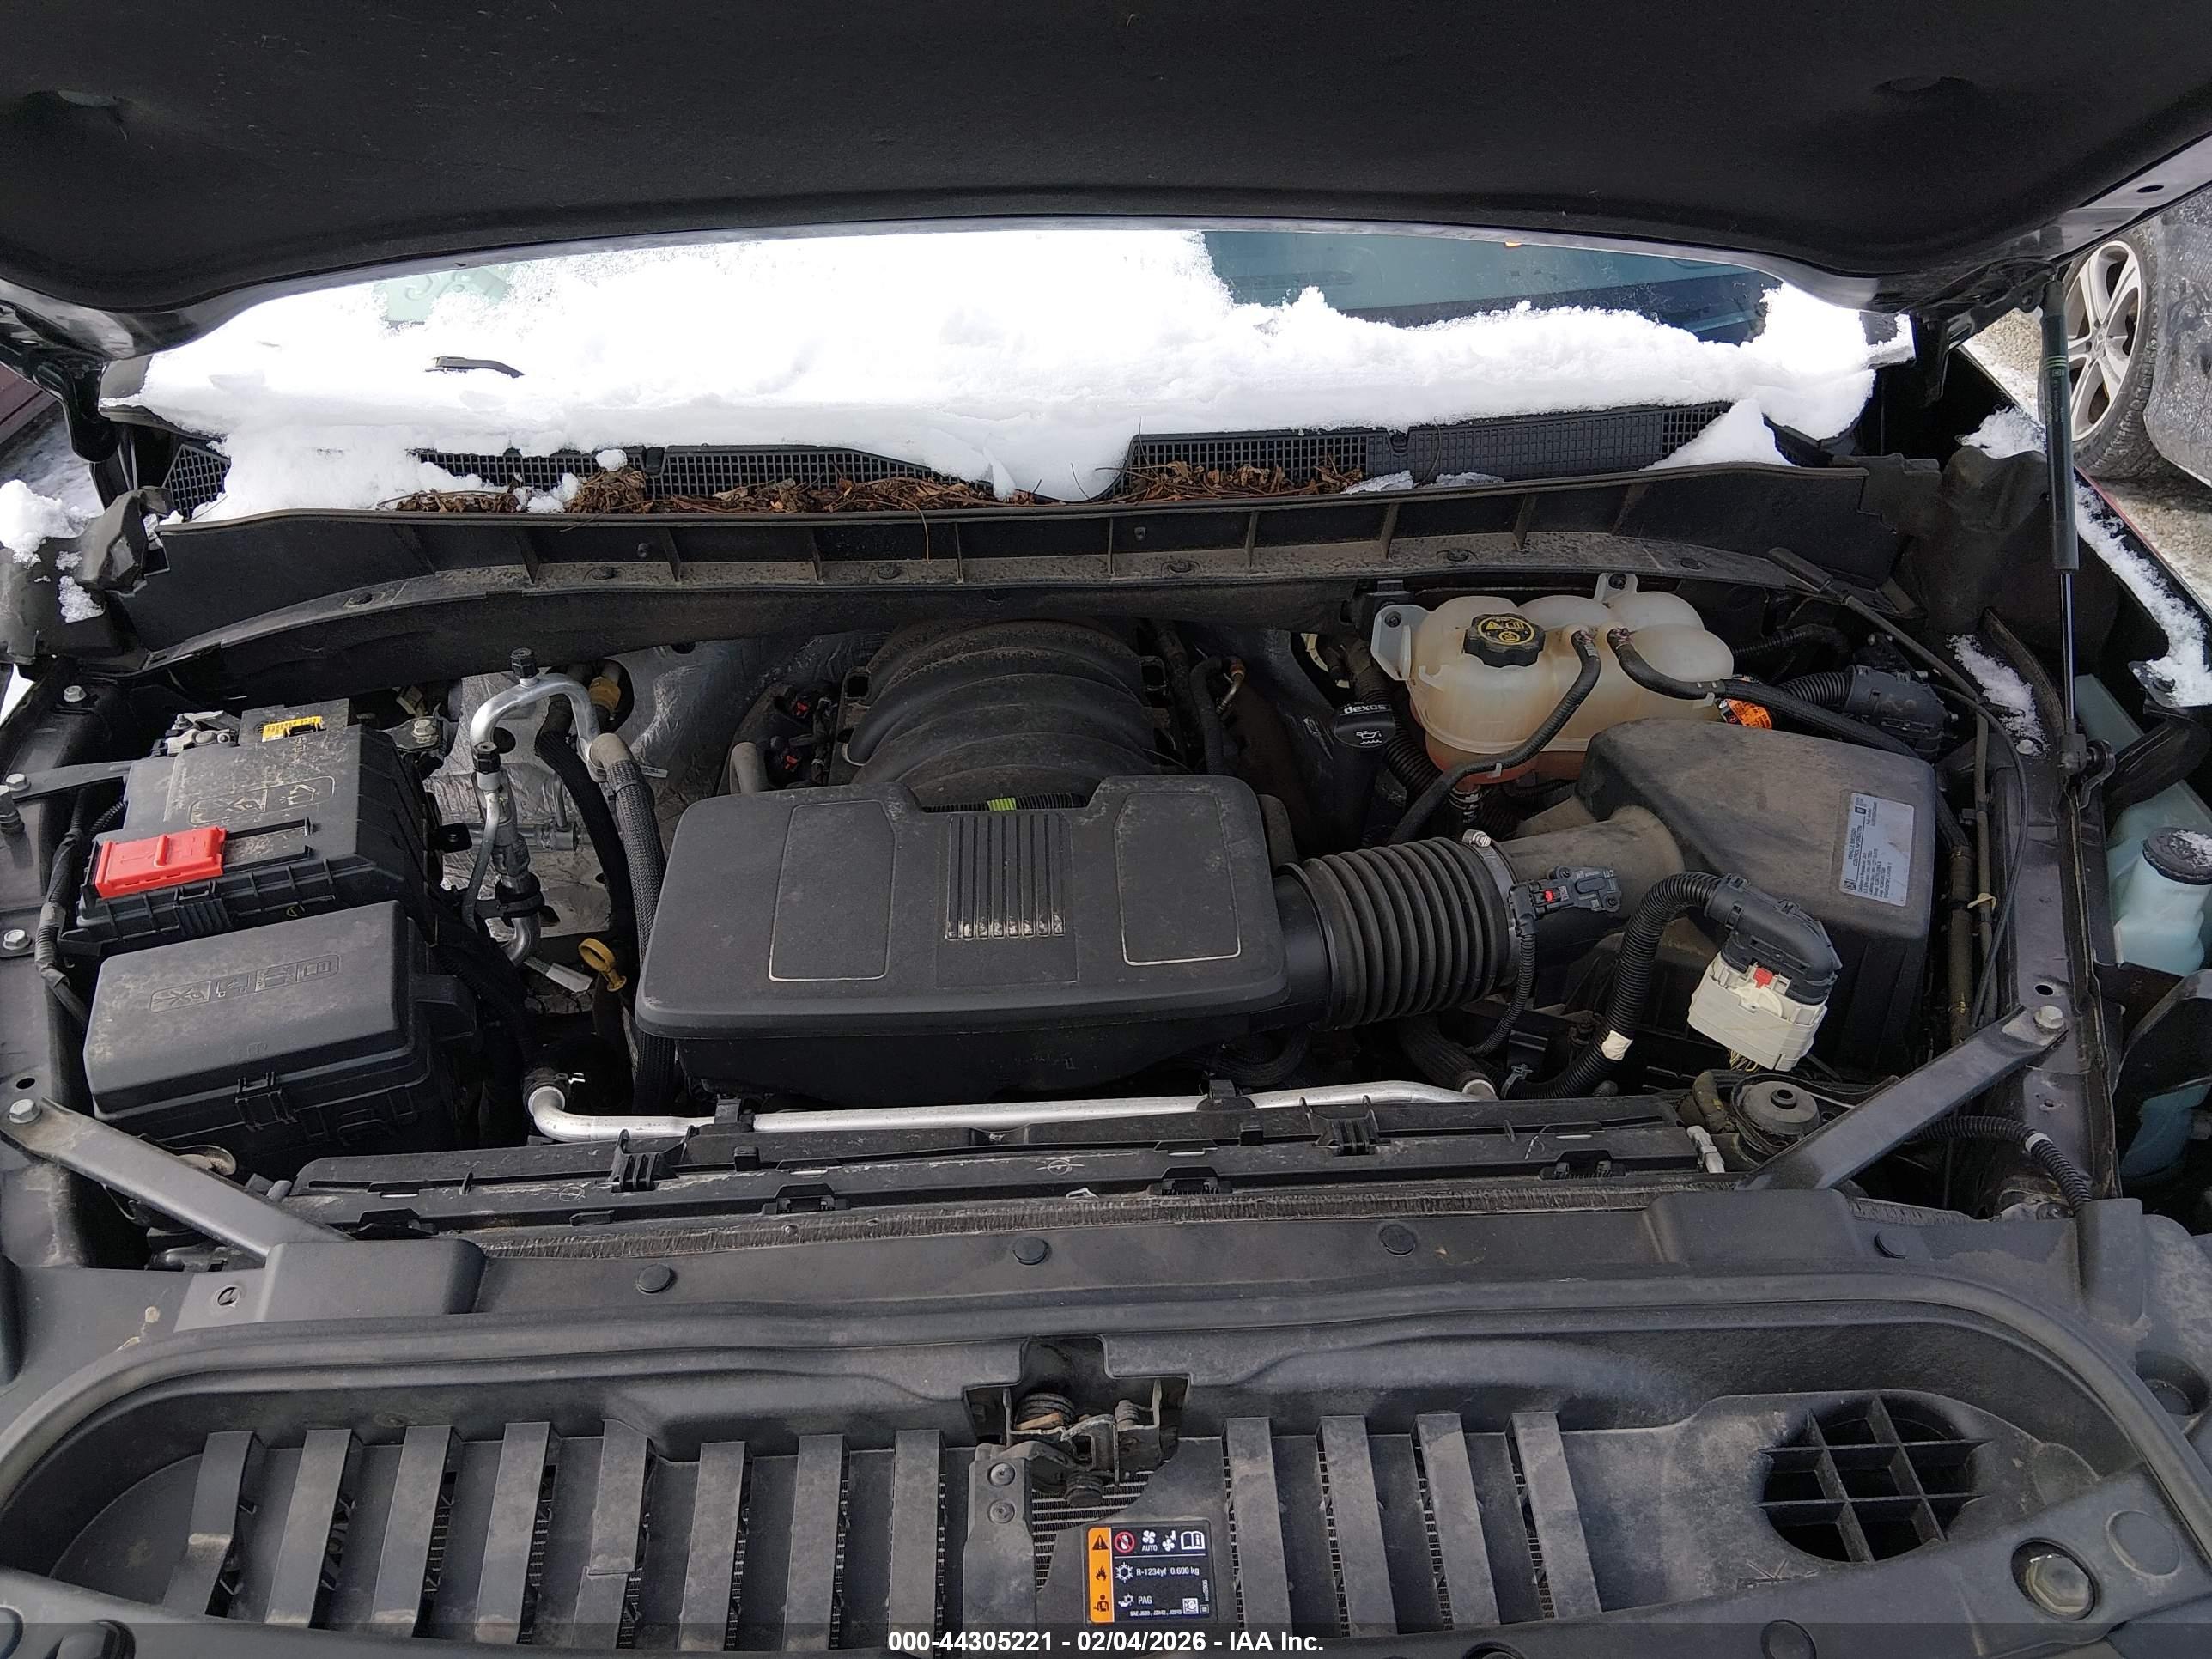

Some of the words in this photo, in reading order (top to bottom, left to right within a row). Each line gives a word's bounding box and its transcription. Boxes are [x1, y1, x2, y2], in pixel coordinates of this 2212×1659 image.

[1344, 704, 1387, 714] dexos
[1136, 1567, 1167, 1577] R-1234yf
[1170, 1567, 1189, 1576] 0.600
[1190, 1566, 1200, 1576] kg
[1138, 1596, 1152, 1605] PAG
